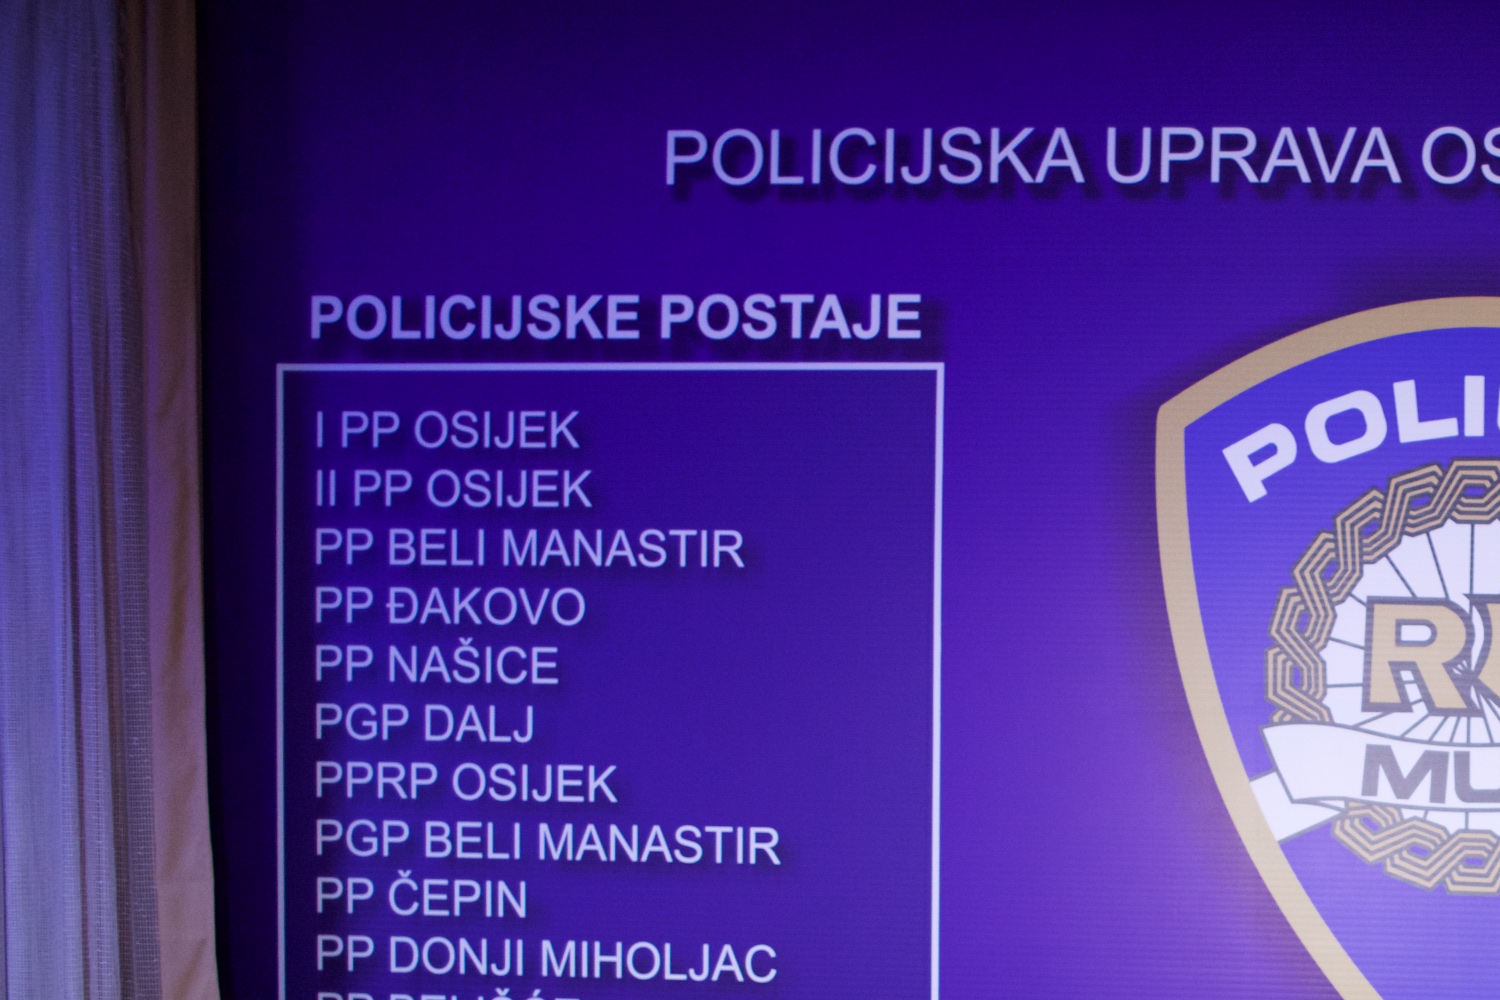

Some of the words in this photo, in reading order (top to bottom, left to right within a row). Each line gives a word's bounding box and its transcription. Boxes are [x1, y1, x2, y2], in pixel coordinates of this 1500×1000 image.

[665, 127, 1085, 187] POLICIJSKA
[1107, 126, 1402, 185] UPRAVA
[310, 294, 641, 341] POLICIJSKE
[659, 293, 923, 341] POSTAJE
[315, 411, 323, 448] I
[341, 411, 402, 448] PP
[414, 410, 581, 450] OSIJEK
[316, 470, 337, 507] II
[353, 470, 414, 507] PP
[426, 469, 593, 508] OSIJEK
[314, 528, 374, 566] PP
[387, 528, 486, 566] BELI
[501, 528, 745, 569] MANASTIR
[314, 586, 374, 623] PP
[385, 586, 587, 626] ĐAKOVO
[314, 645, 374, 682] PP
[387, 636, 560, 685] NAŠICE
[314, 702, 410, 740] PGP
[424, 703, 536, 744] DALJ
[314, 761, 439, 799] PPRP
[451, 763, 619, 803] OSIJEK
[314, 819, 410, 857] PGP
[425, 822, 522, 860] BELI
[537, 823, 782, 866] MANASTIR
[315, 877, 375, 914] PP
[388, 869, 528, 918] ČEPIN
[315, 935, 375, 972] PP
[389, 936, 525, 977] DONJI
[541, 940, 778, 983] MIHOLJAC
